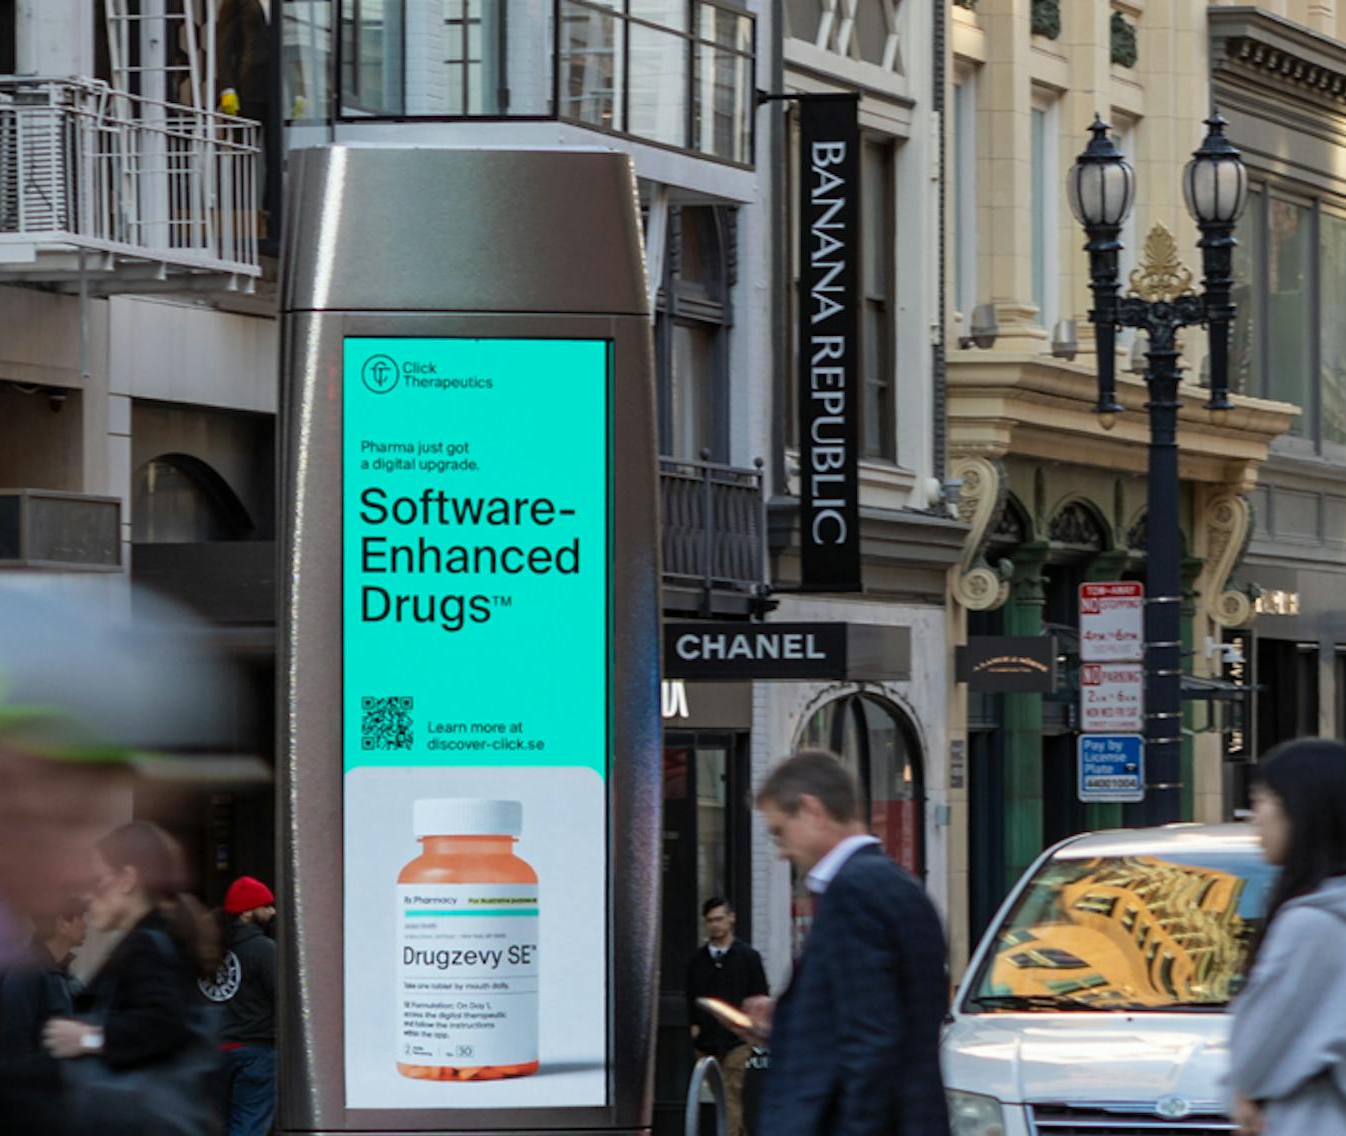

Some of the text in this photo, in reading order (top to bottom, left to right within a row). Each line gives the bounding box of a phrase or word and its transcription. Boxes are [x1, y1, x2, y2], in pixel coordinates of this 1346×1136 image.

[810, 141, 848, 546] BANANA REPUBLIC
[403, 361, 437, 374] Click
[403, 375, 493, 389] Therapeutics
[361, 441, 469, 456] Pharma just got
[360, 458, 480, 473] a digital upgrade.
[359, 487, 576, 525] Software-
[361, 536, 580, 574] Enhanced
[676, 633, 826, 660] CHANEL
[427, 721, 523, 733] Learn more at
[427, 738, 545, 751] discover-click.se
[1084, 739, 1124, 753] Pay by
[1084, 751, 1127, 763] License
[1084, 763, 1115, 774] Plate
[414, 896, 457, 905] Pharmacy
[403, 945, 503, 970] Drugzevy
[470, 1002, 485, 1010] Day
[438, 1011, 462, 1020] digital
